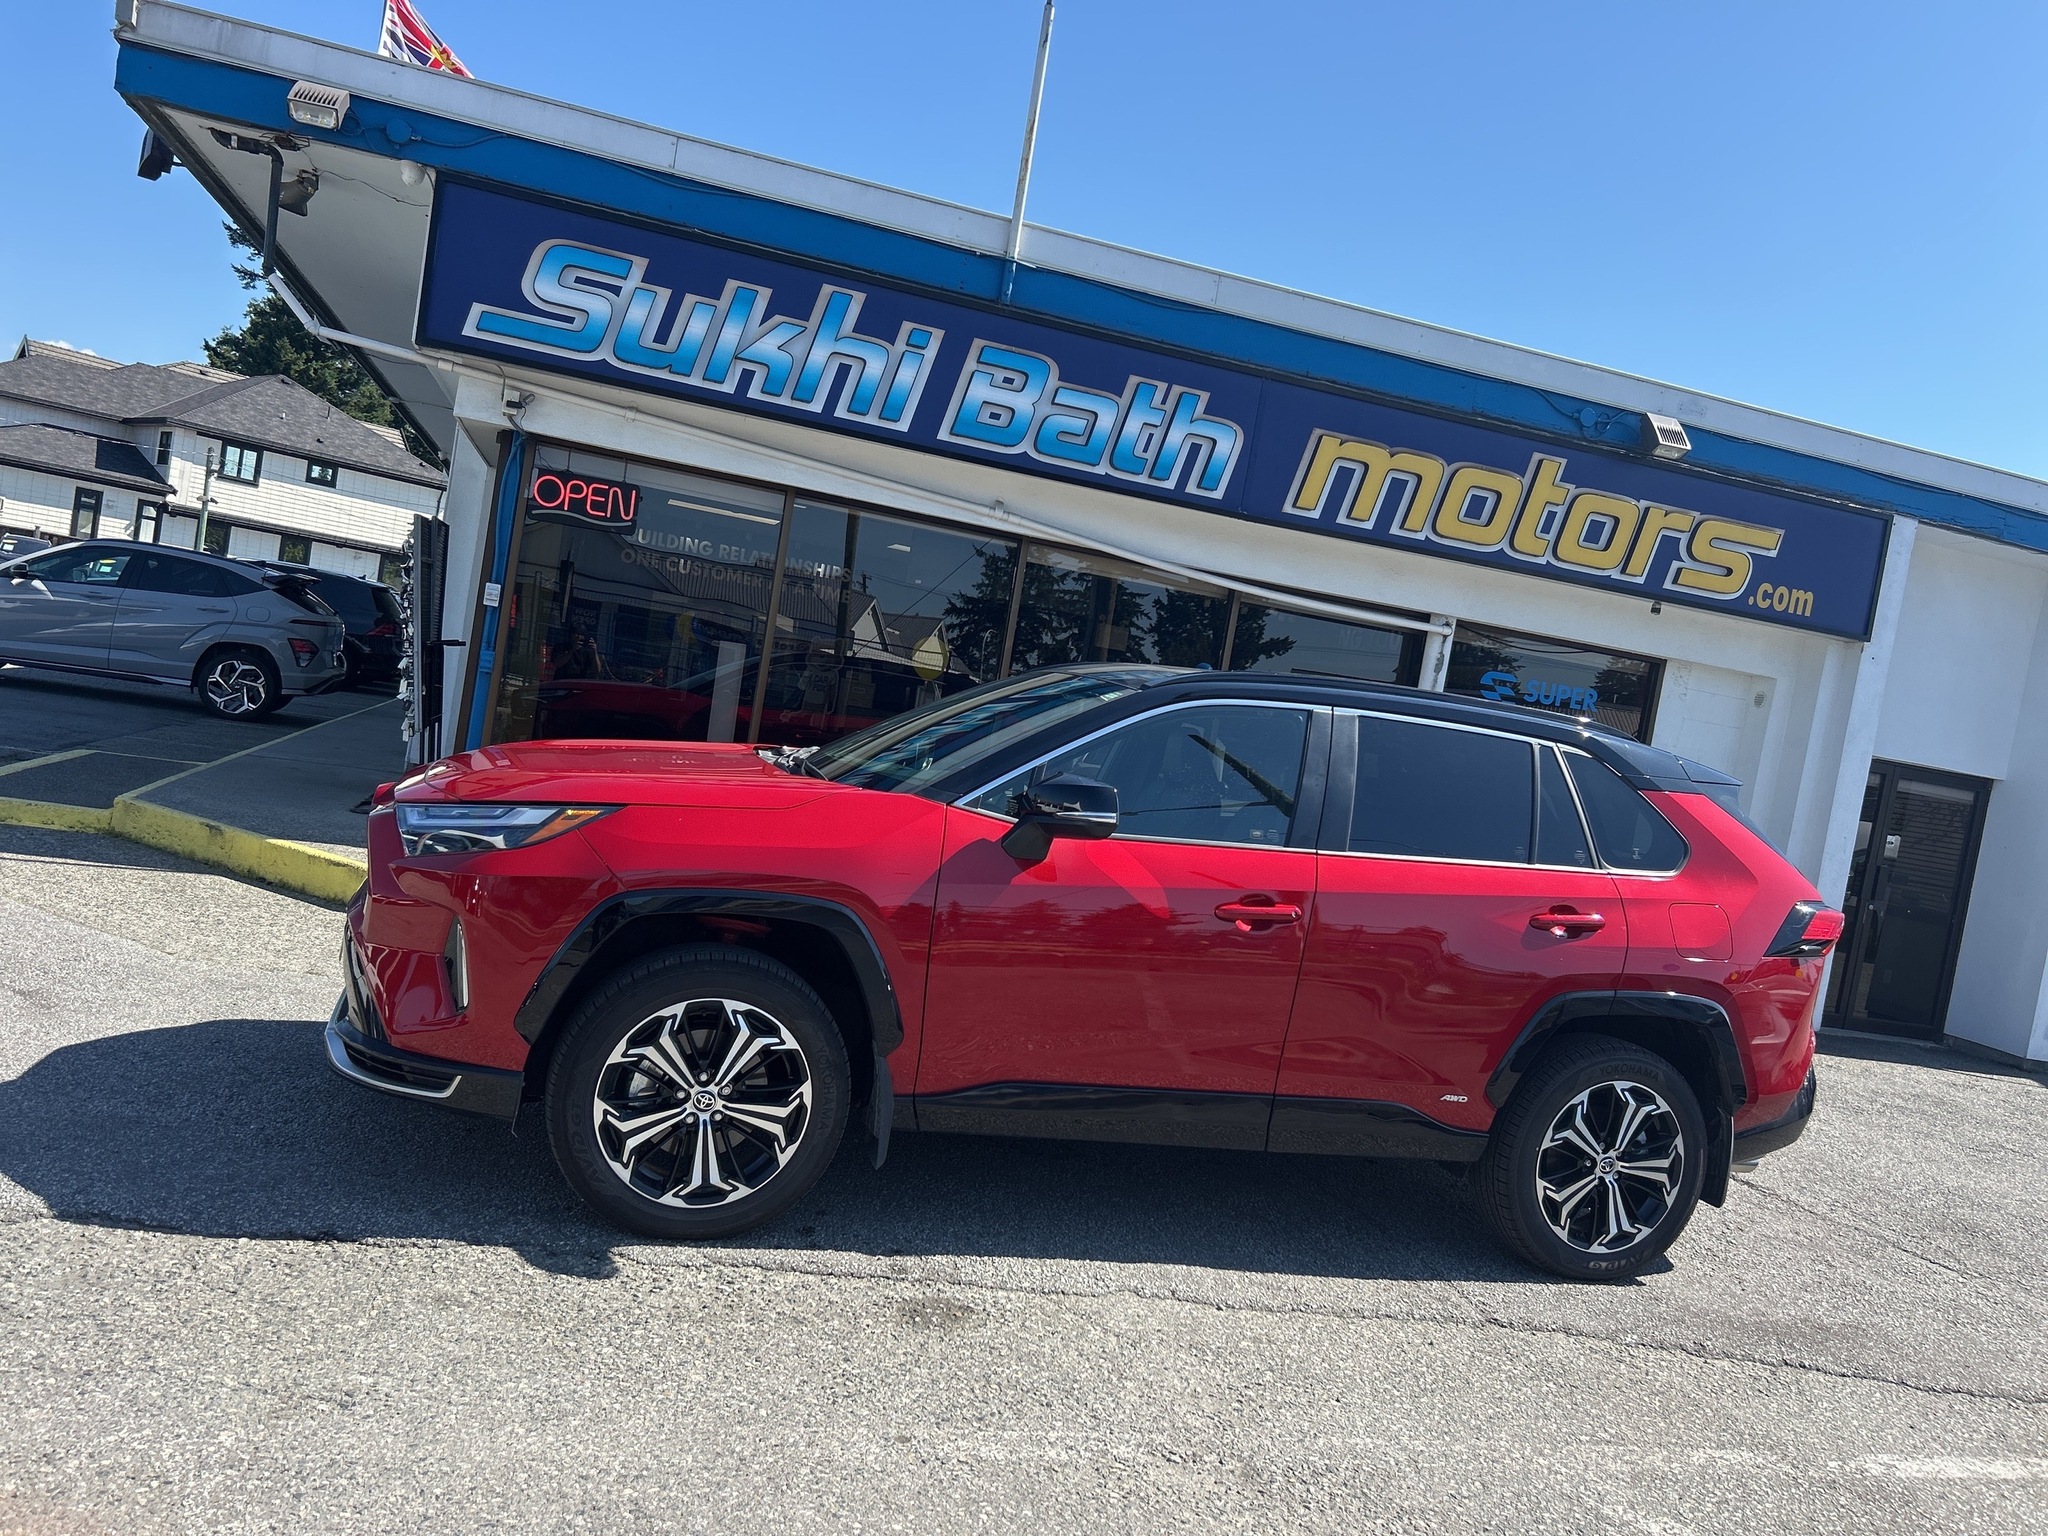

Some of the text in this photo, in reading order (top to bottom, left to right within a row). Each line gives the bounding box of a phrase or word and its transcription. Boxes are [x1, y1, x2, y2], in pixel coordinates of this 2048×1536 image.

[463, 239, 1814, 617] Sukhi Bath motors .com
[534, 475, 636, 520] OPEN
[621, 548, 659, 568] ONE
[666, 556, 762, 588] CUSTOMER
[719, 544, 852, 582] RELATINSHIPS
[1523, 679, 1599, 712] SUPER
[816, 1043, 835, 1130] YOKOHAMA
[1600, 1062, 1660, 1082] YOKOHAMA
[1440, 1094, 1468, 1103] AWD
